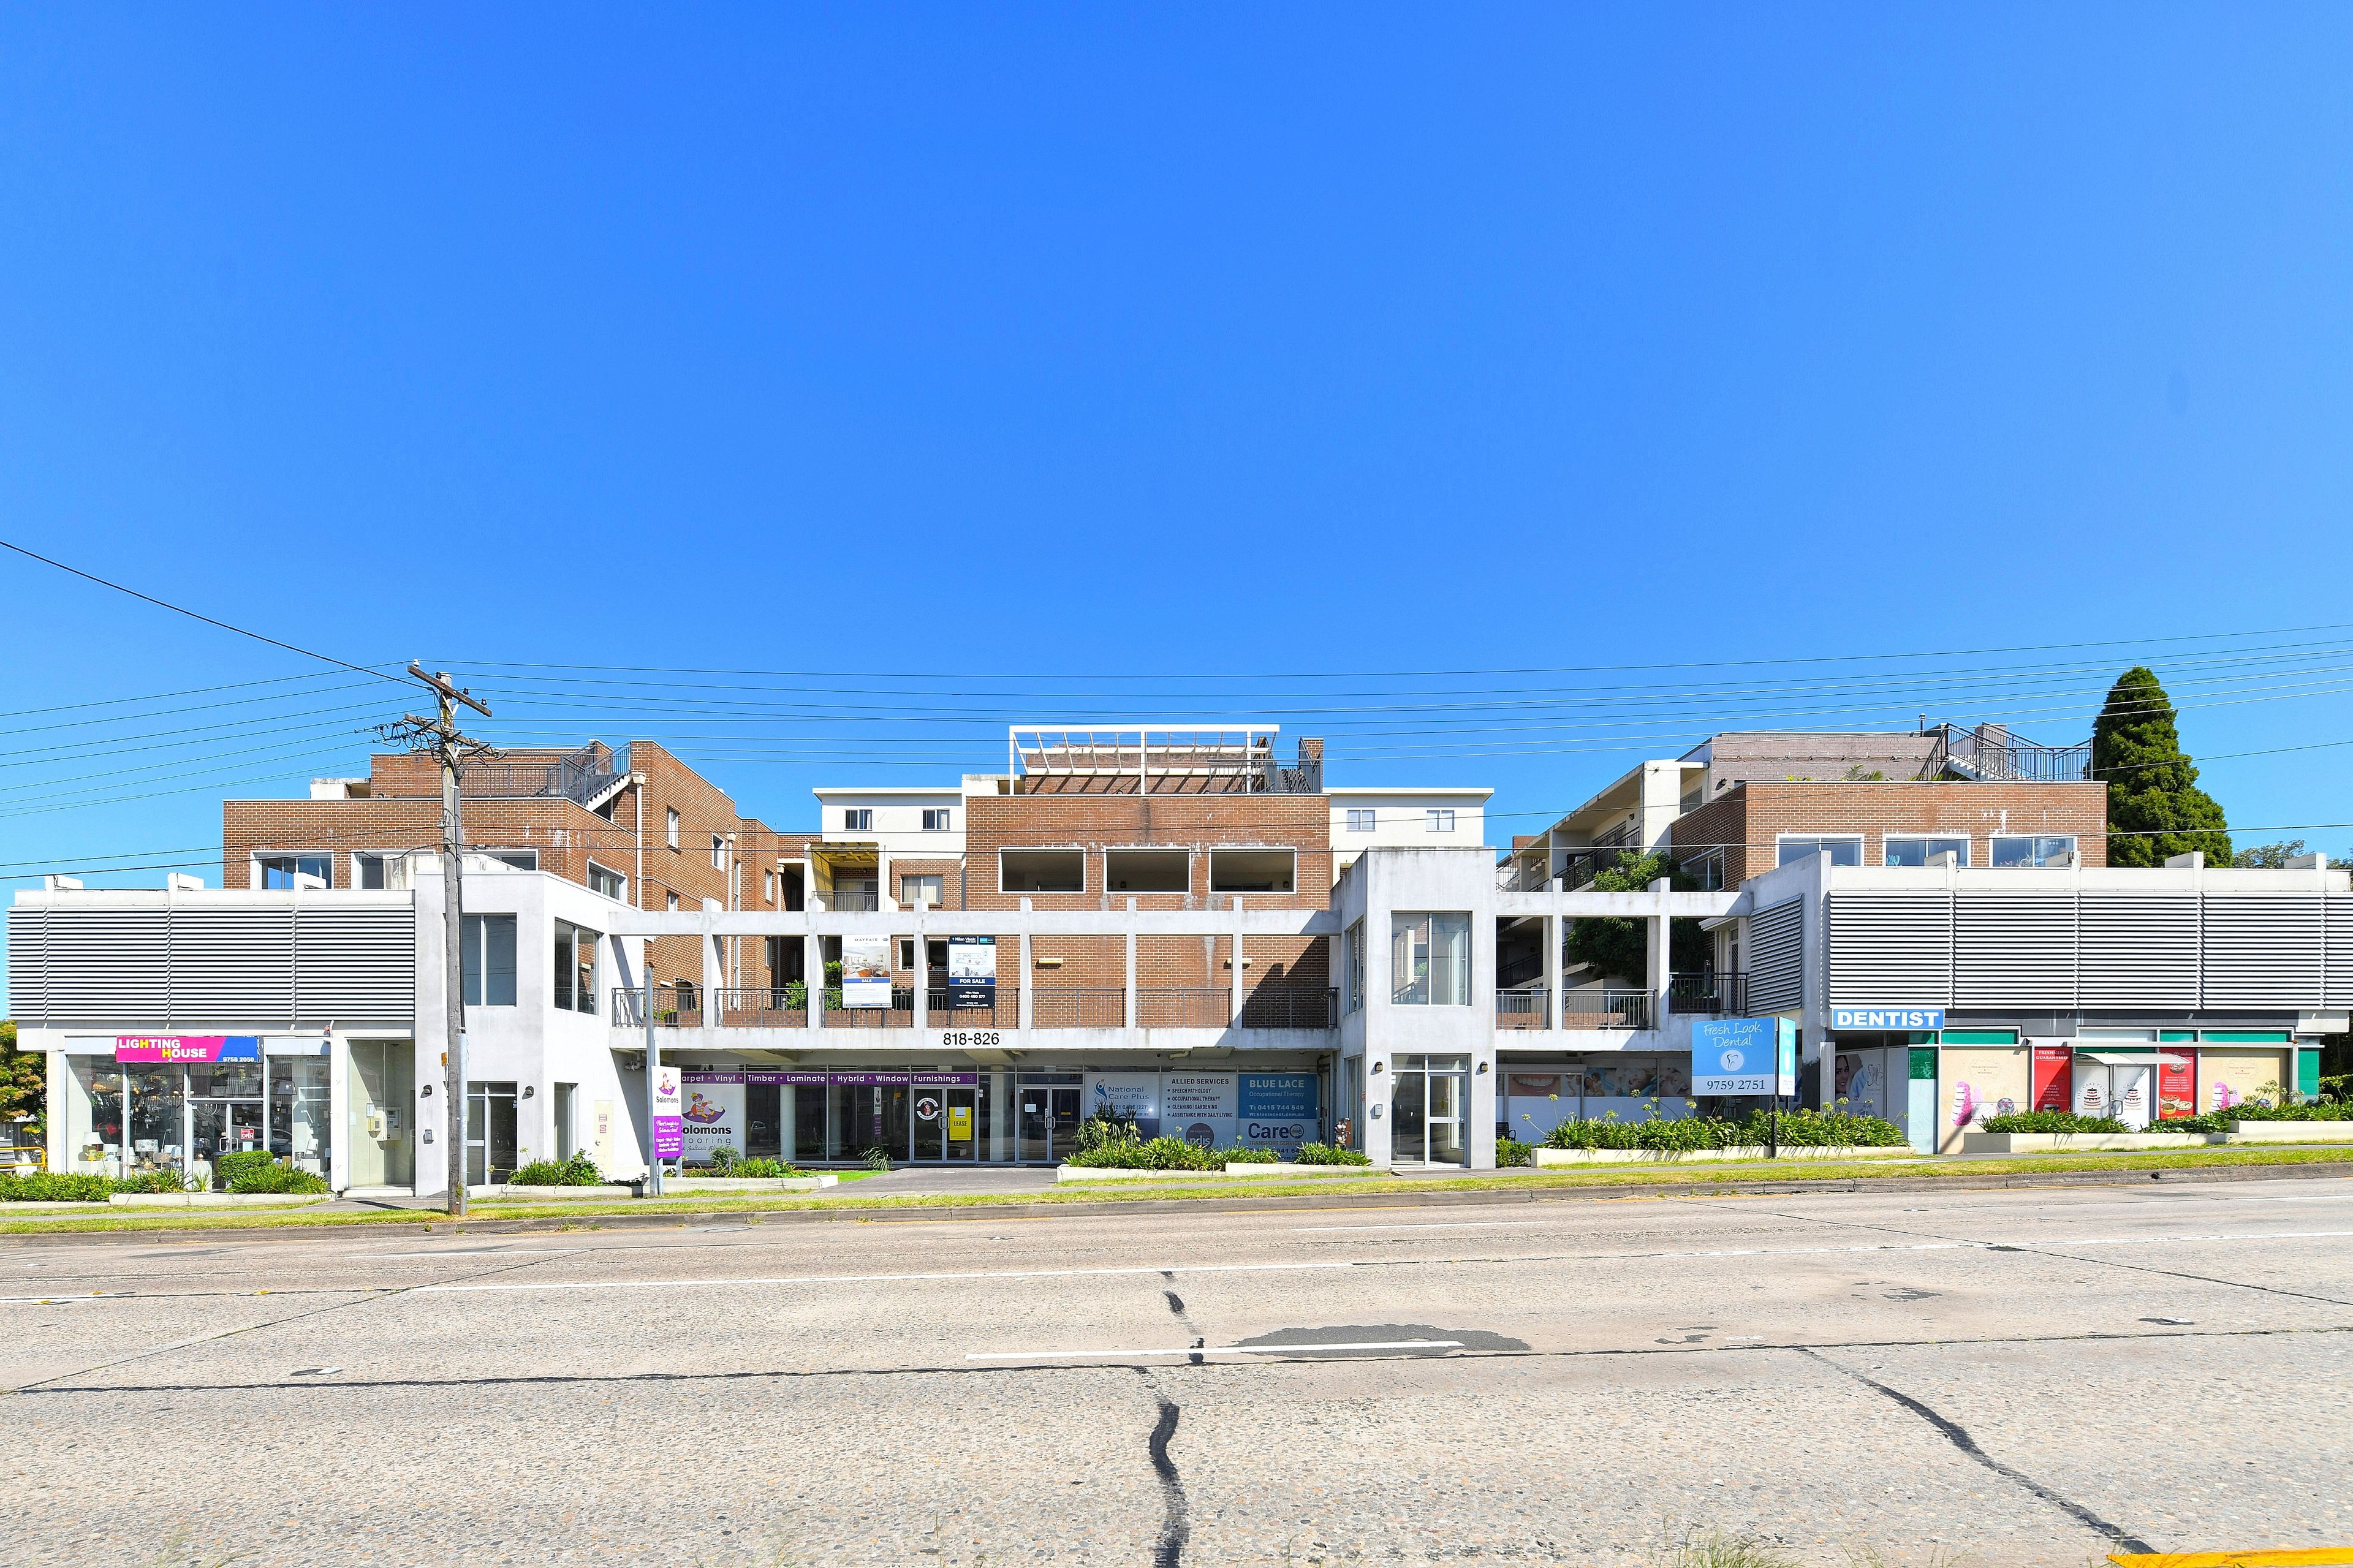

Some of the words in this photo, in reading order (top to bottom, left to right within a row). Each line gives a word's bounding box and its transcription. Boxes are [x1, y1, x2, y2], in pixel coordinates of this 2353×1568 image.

[1837, 1012, 1939, 1026] DENTIST
[1703, 1023, 1730, 1036] Fresh
[1733, 1021, 1762, 1034] Look
[943, 1032, 999, 1045] 818-826
[1713, 1034, 1752, 1048] Dental
[118, 1039, 181, 1049] LIGHTING
[162, 1048, 207, 1058] HOUSE
[714, 1074, 735, 1083] Vinyl
[837, 1075, 865, 1084] Hybrid
[1249, 1080, 1276, 1088] BLUE
[1278, 1080, 1305, 1088] LACE
[1707, 1080, 1734, 1090] 9759
[1738, 1080, 1765, 1089] 2751
[681, 1124, 732, 1135] olomons
[683, 1136, 731, 1146] looring
[1189, 1135, 1211, 1146] ndis
